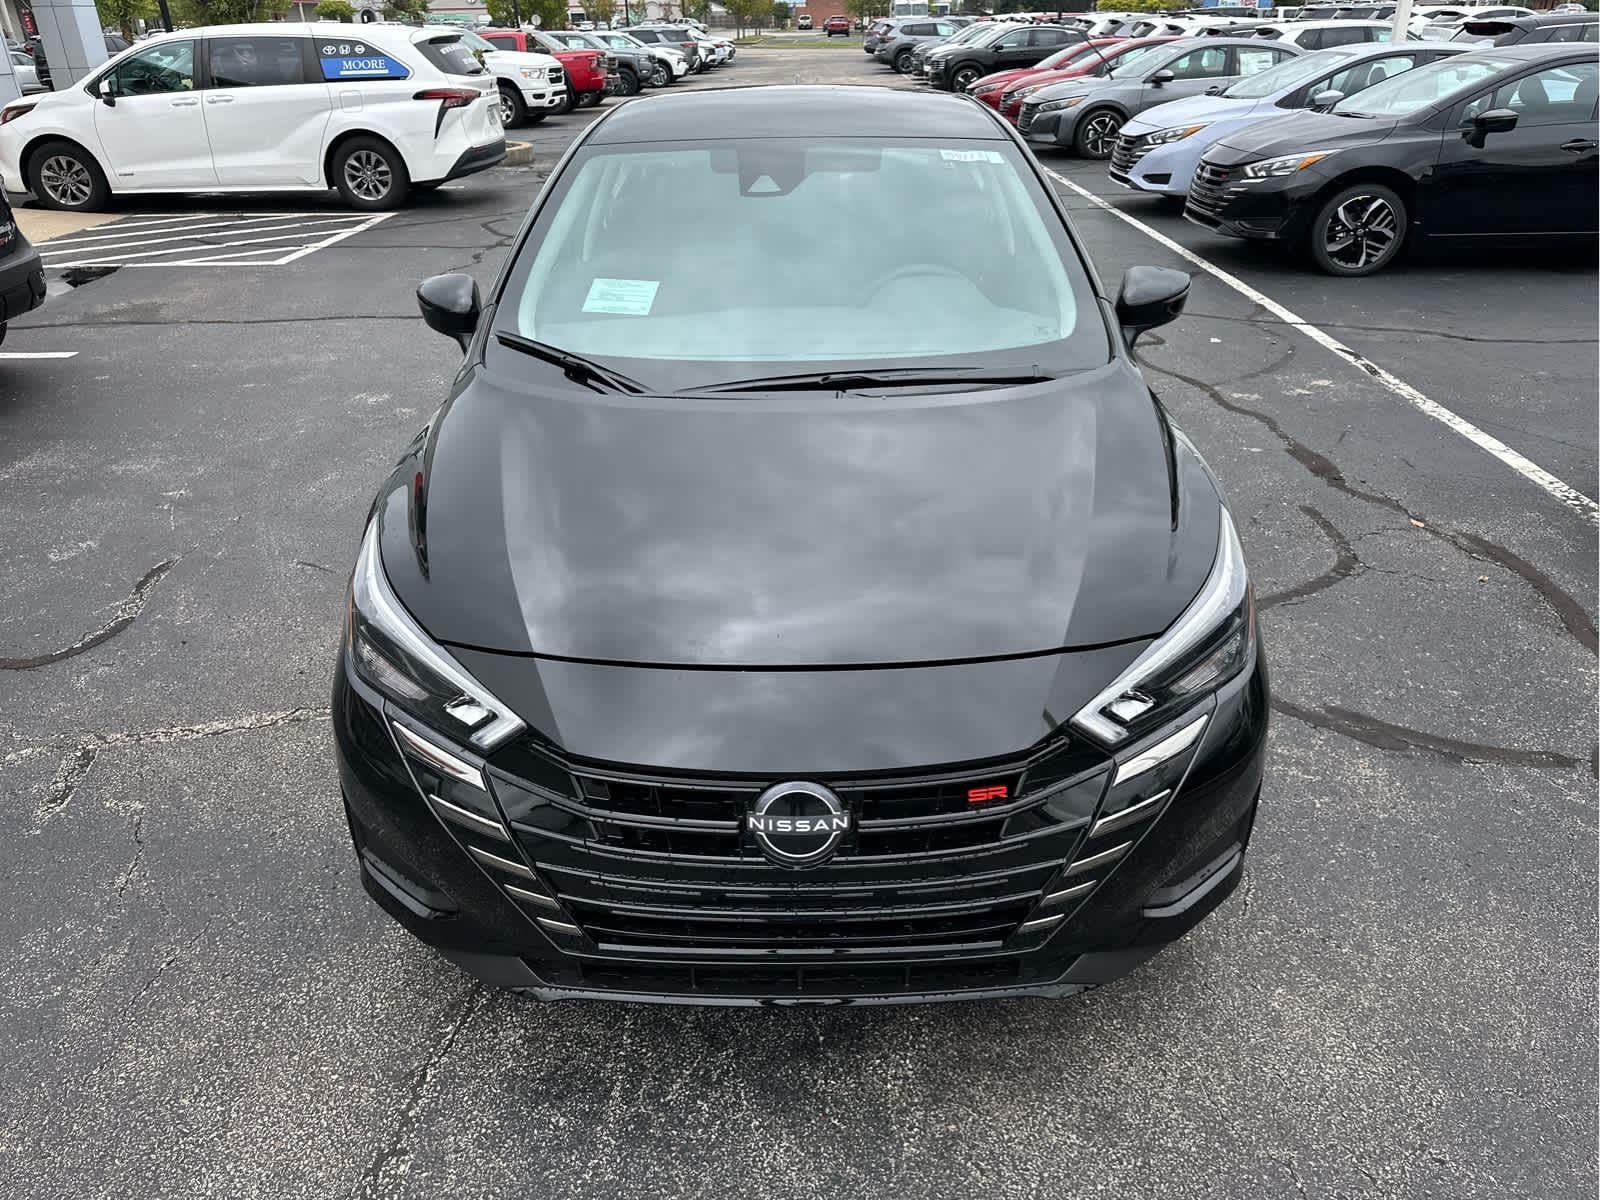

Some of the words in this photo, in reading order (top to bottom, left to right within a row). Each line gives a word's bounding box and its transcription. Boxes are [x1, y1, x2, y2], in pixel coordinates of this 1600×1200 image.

[343, 59, 386, 70] MOORE
[968, 786, 1008, 802] SR
[749, 816, 848, 832] NISSAN
